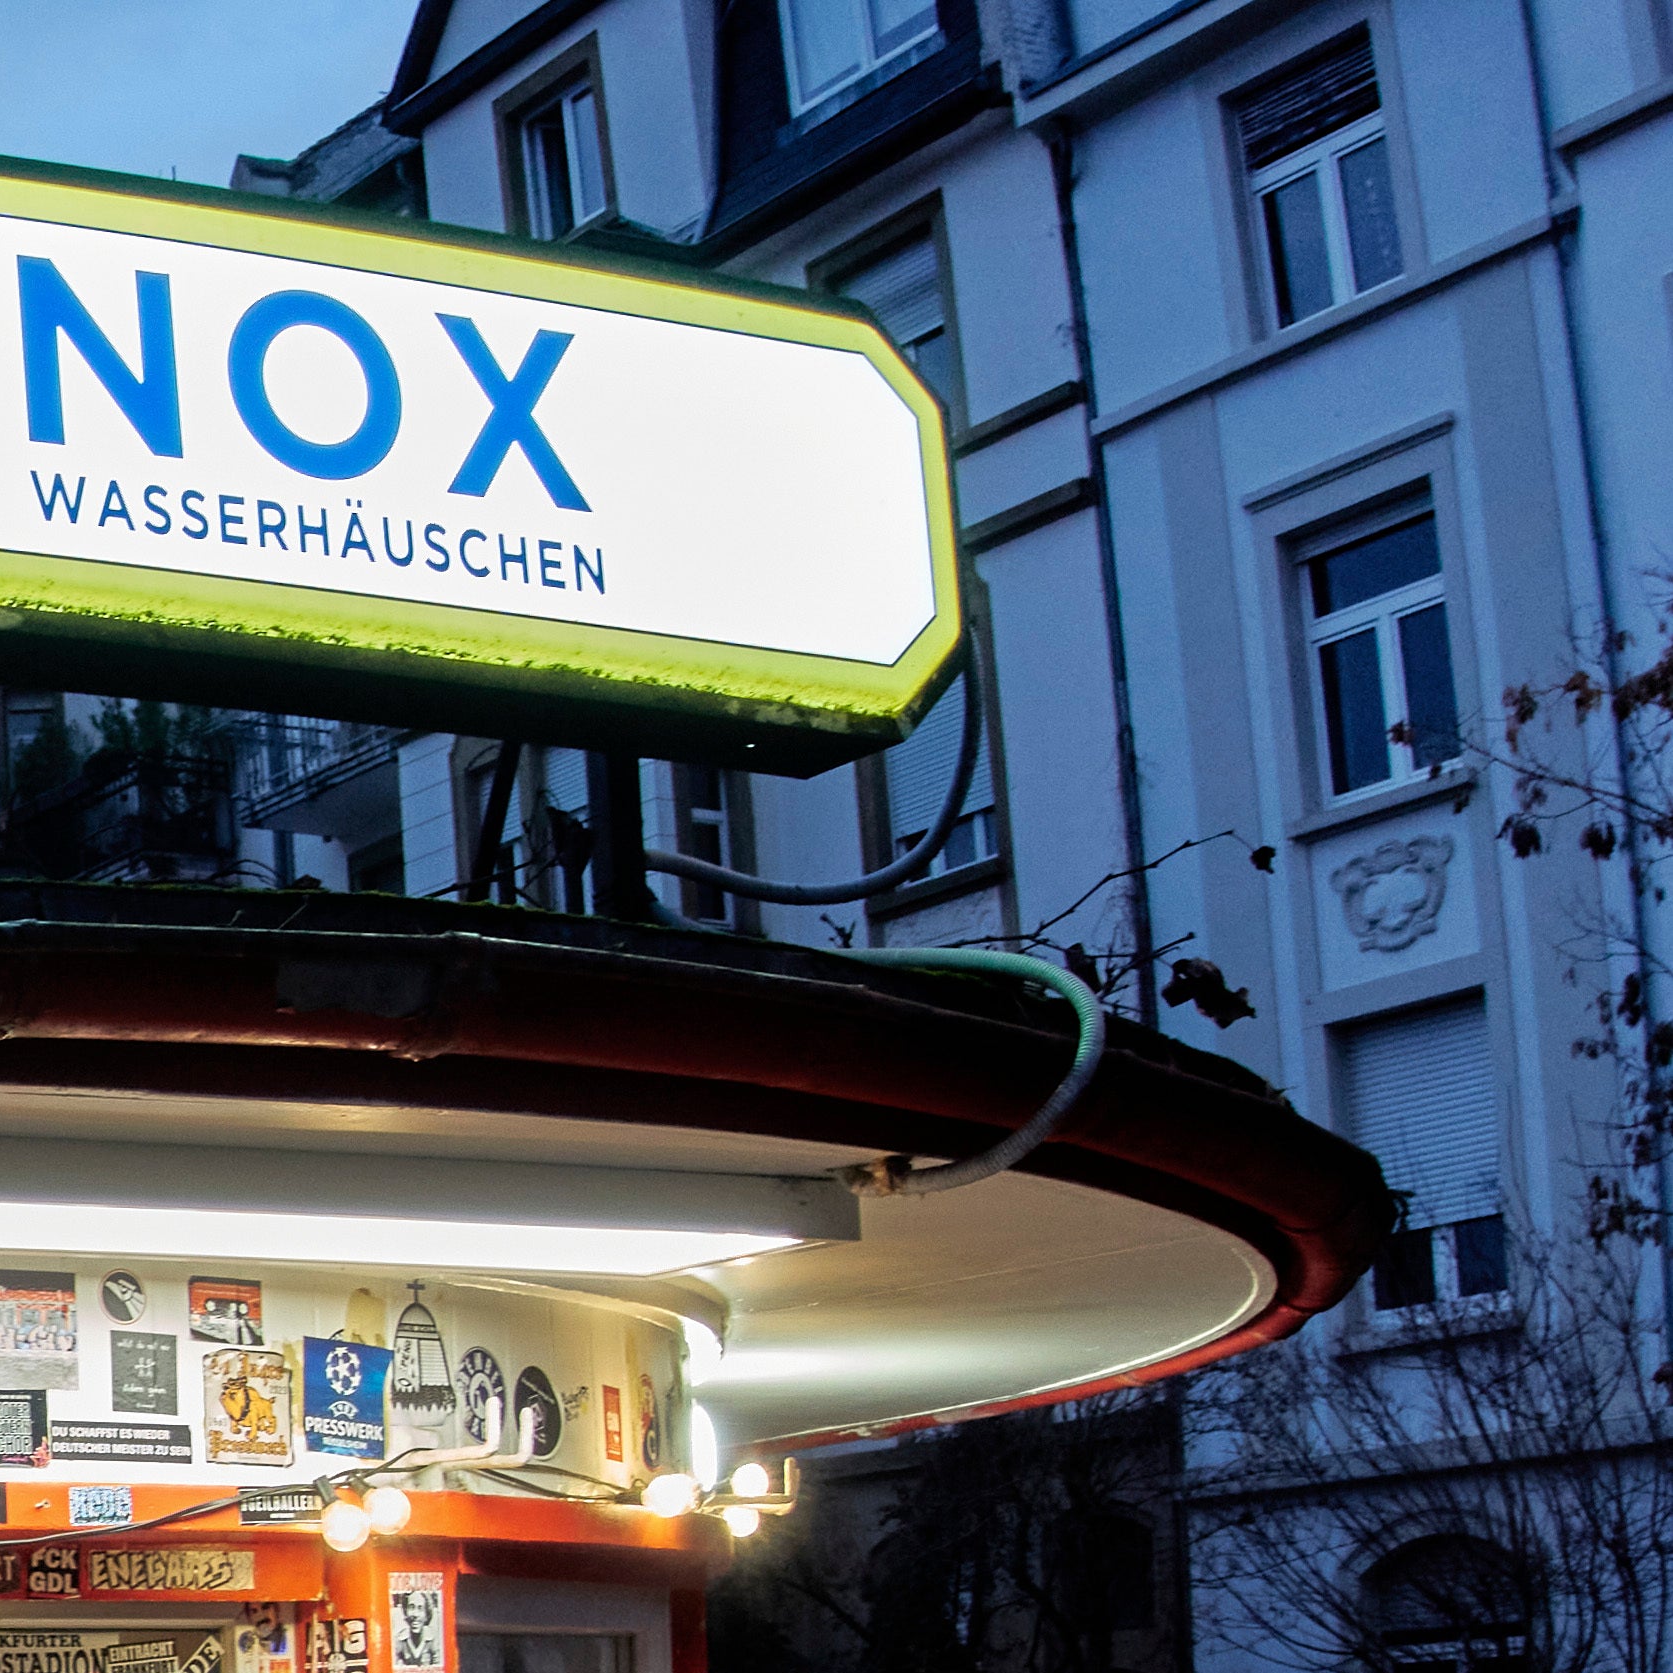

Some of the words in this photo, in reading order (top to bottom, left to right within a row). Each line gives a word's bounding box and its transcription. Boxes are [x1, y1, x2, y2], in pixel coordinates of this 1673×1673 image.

[14, 254, 593, 513] NOX
[32, 466, 608, 594] WASSERHÄUSCHEN
[304, 1416, 385, 1442] PRESSWERK
[30, 1548, 78, 1570] FCK
[29, 1570, 78, 1594] GDL
